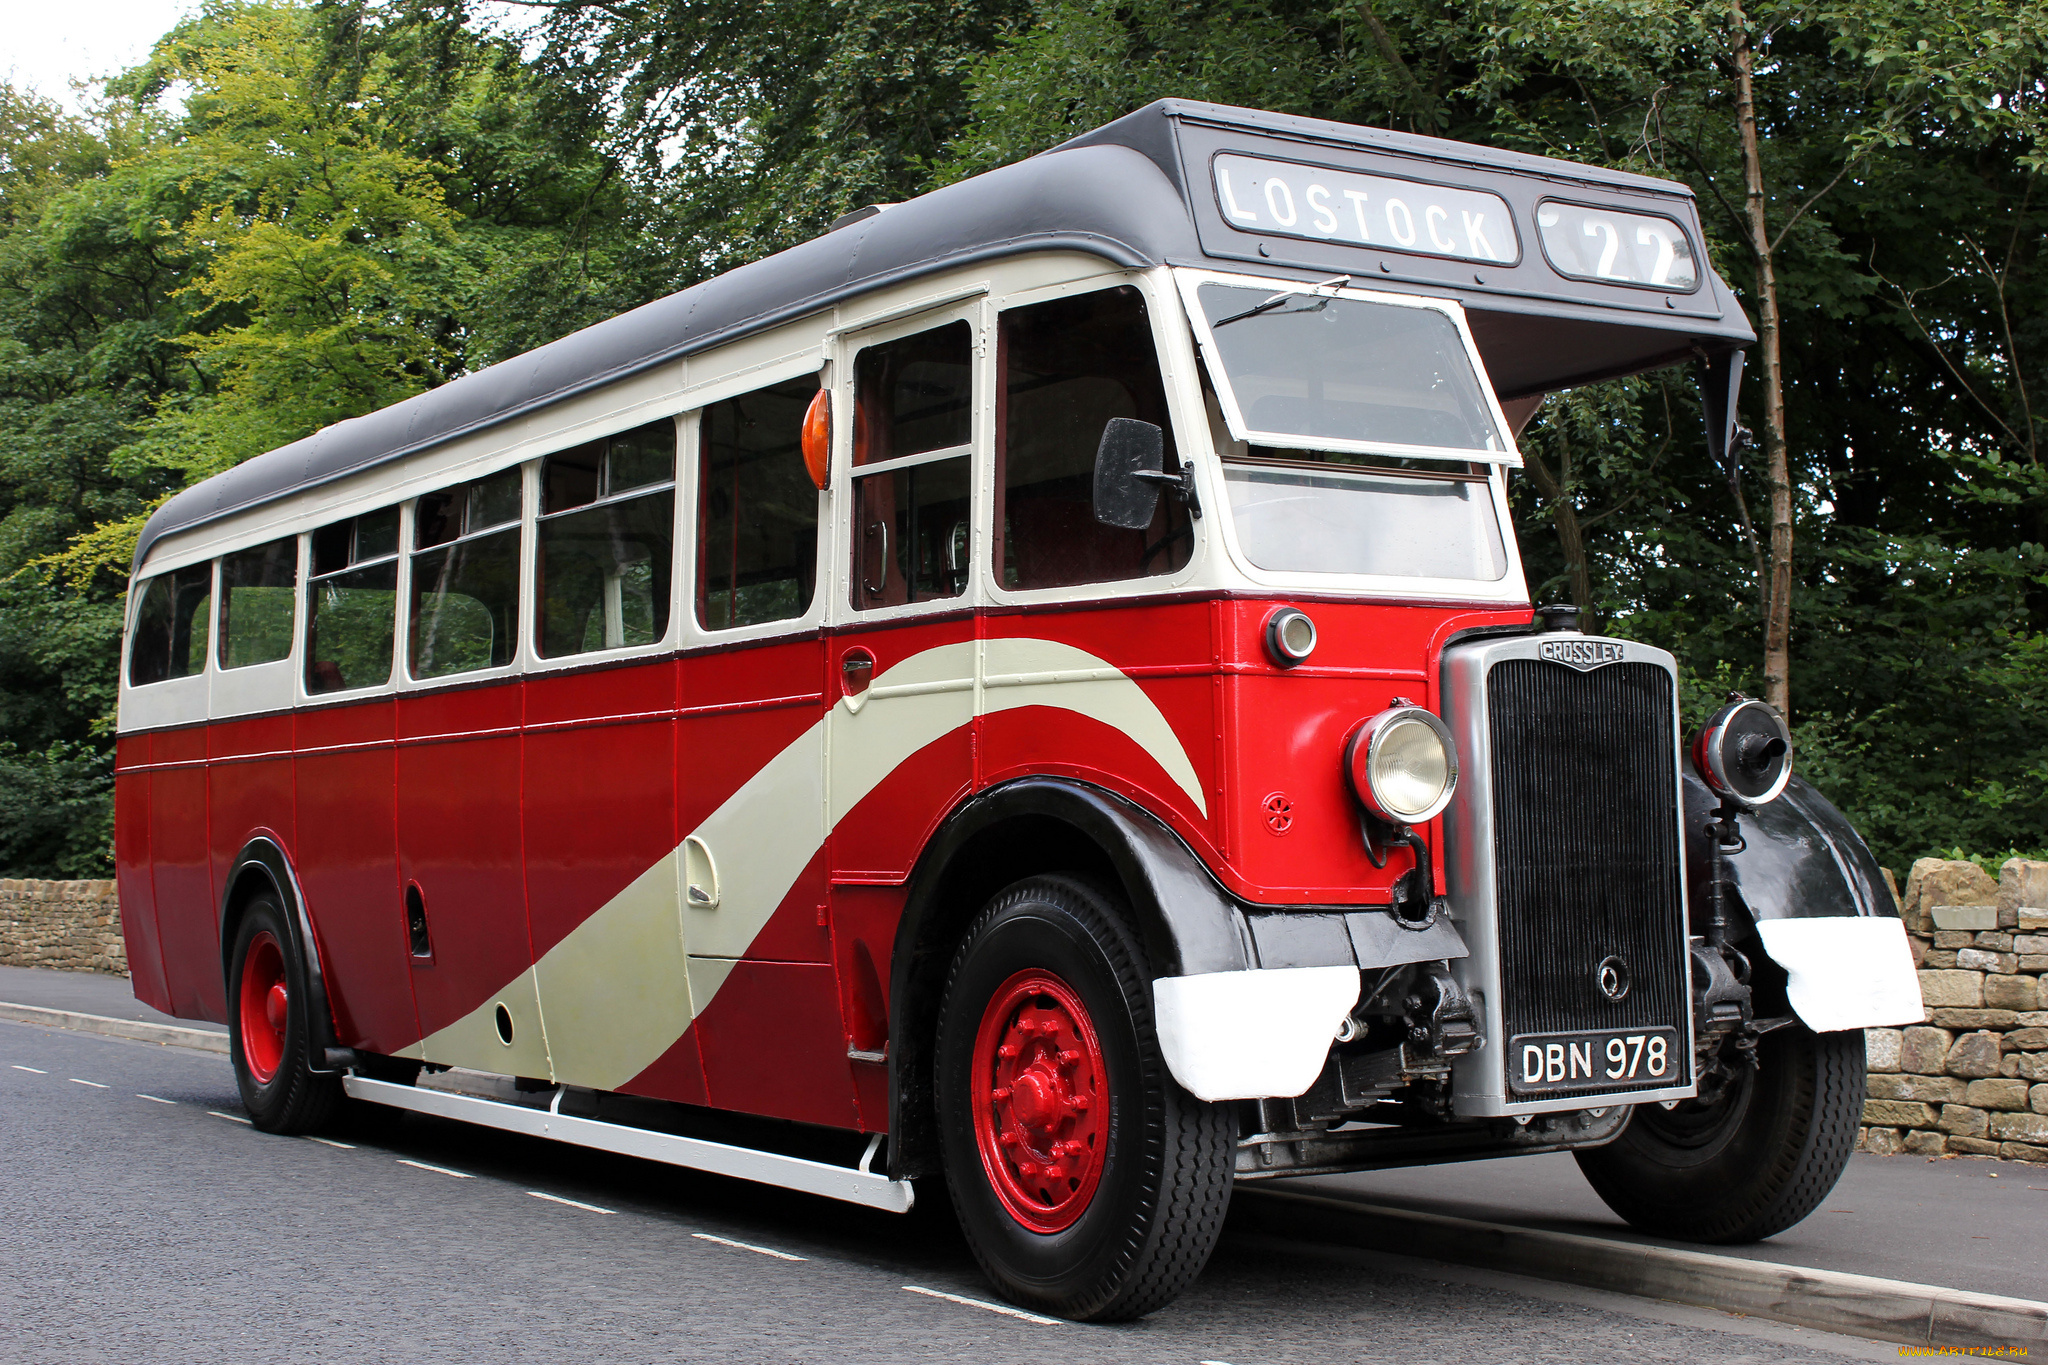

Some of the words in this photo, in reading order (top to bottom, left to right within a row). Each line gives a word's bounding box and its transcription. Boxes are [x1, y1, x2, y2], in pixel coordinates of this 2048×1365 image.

[1220, 168, 1497, 260] LOSTOCK
[1542, 641, 1622, 664] CROSSLEY
[1522, 1042, 1592, 1083] DBN
[1605, 1035, 1667, 1080] 978
